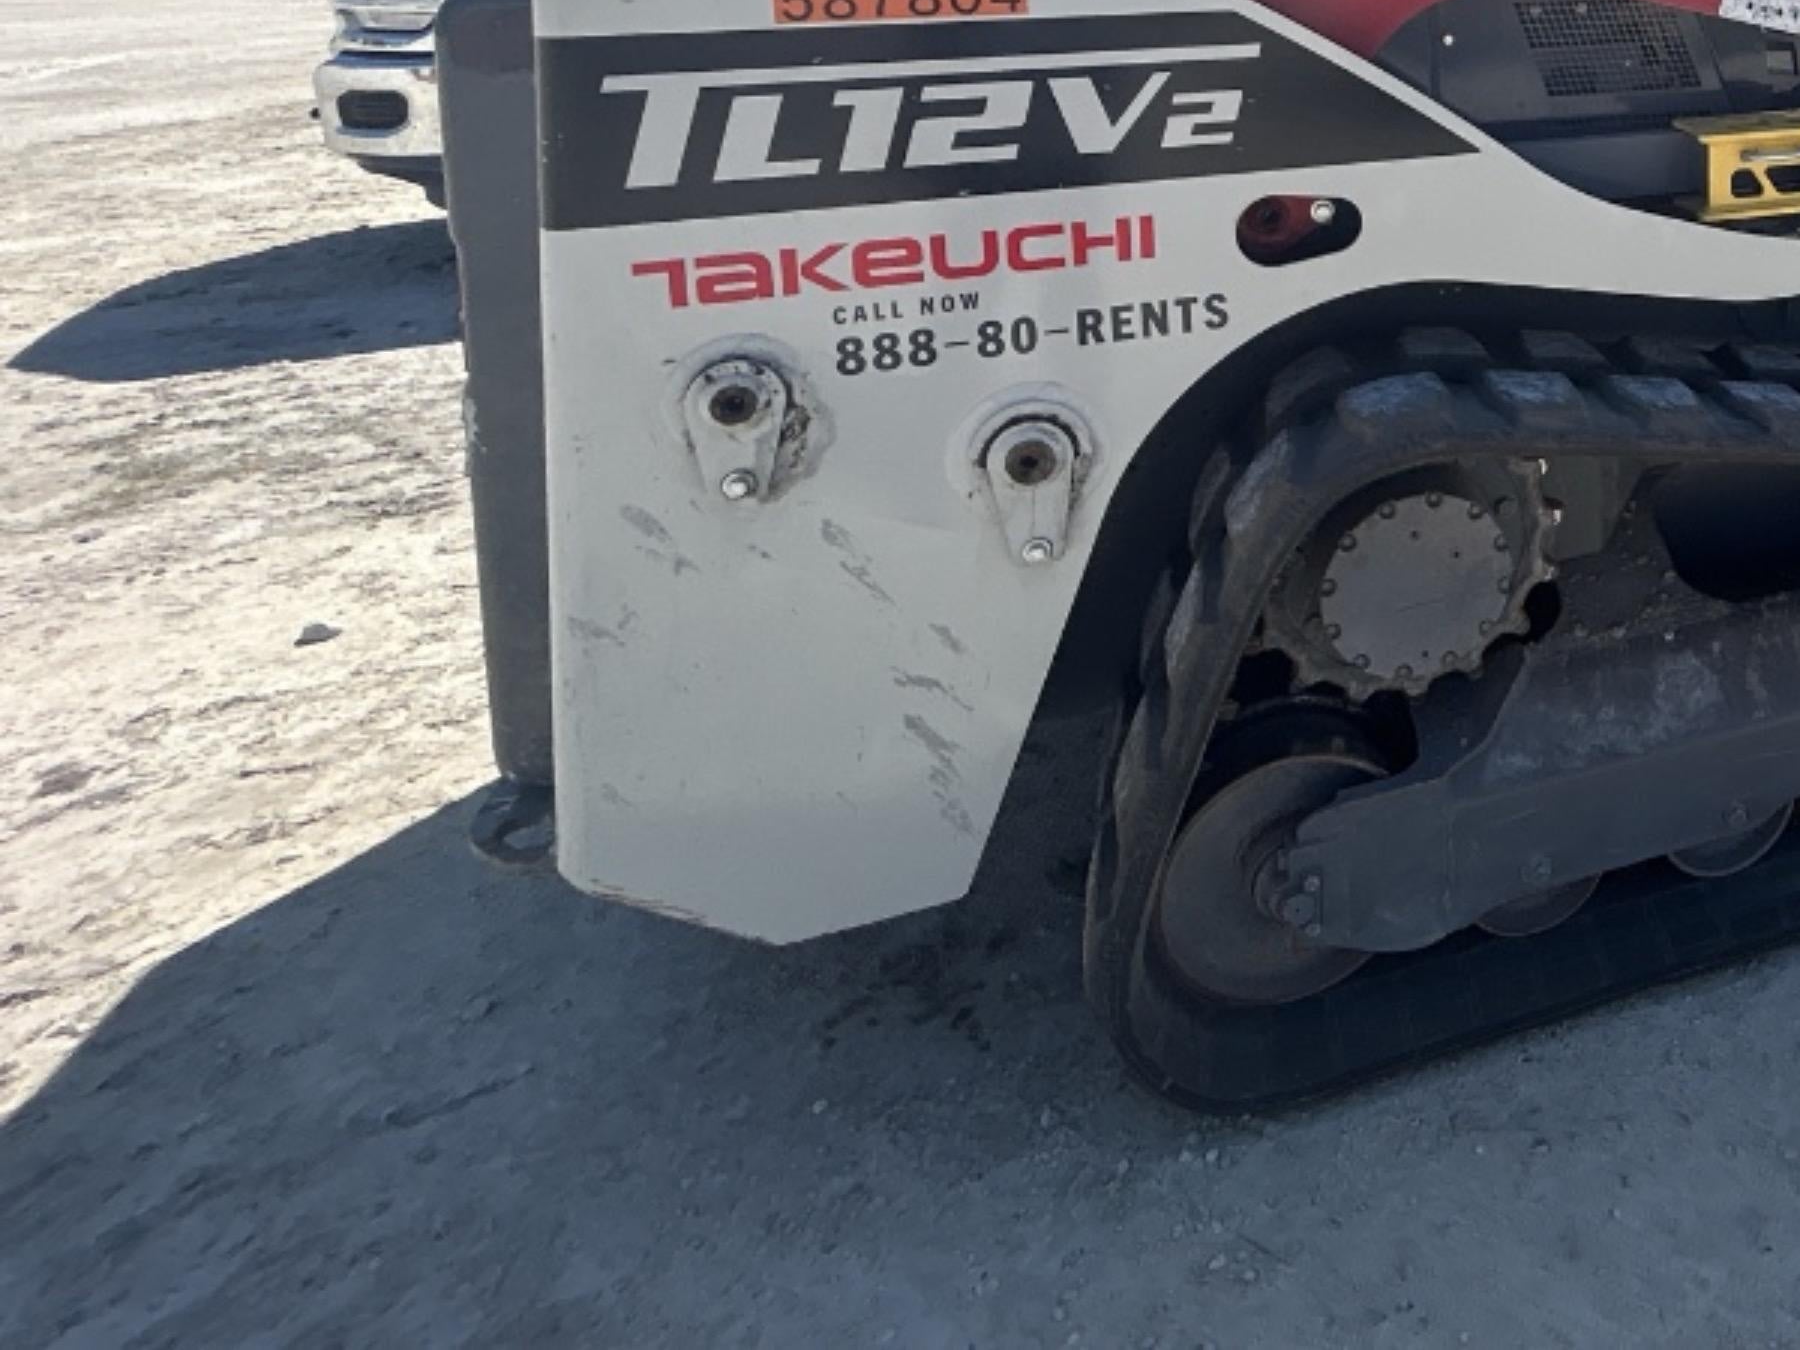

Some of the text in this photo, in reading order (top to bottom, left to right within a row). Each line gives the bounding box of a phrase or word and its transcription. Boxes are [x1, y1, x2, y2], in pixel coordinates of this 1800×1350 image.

[600, 42, 1262, 190] TL12V2
[631, 214, 1157, 310] TAKEUCHI
[832, 291, 982, 326] CALL NOW
[835, 292, 1231, 377] 888-80-RENTS
